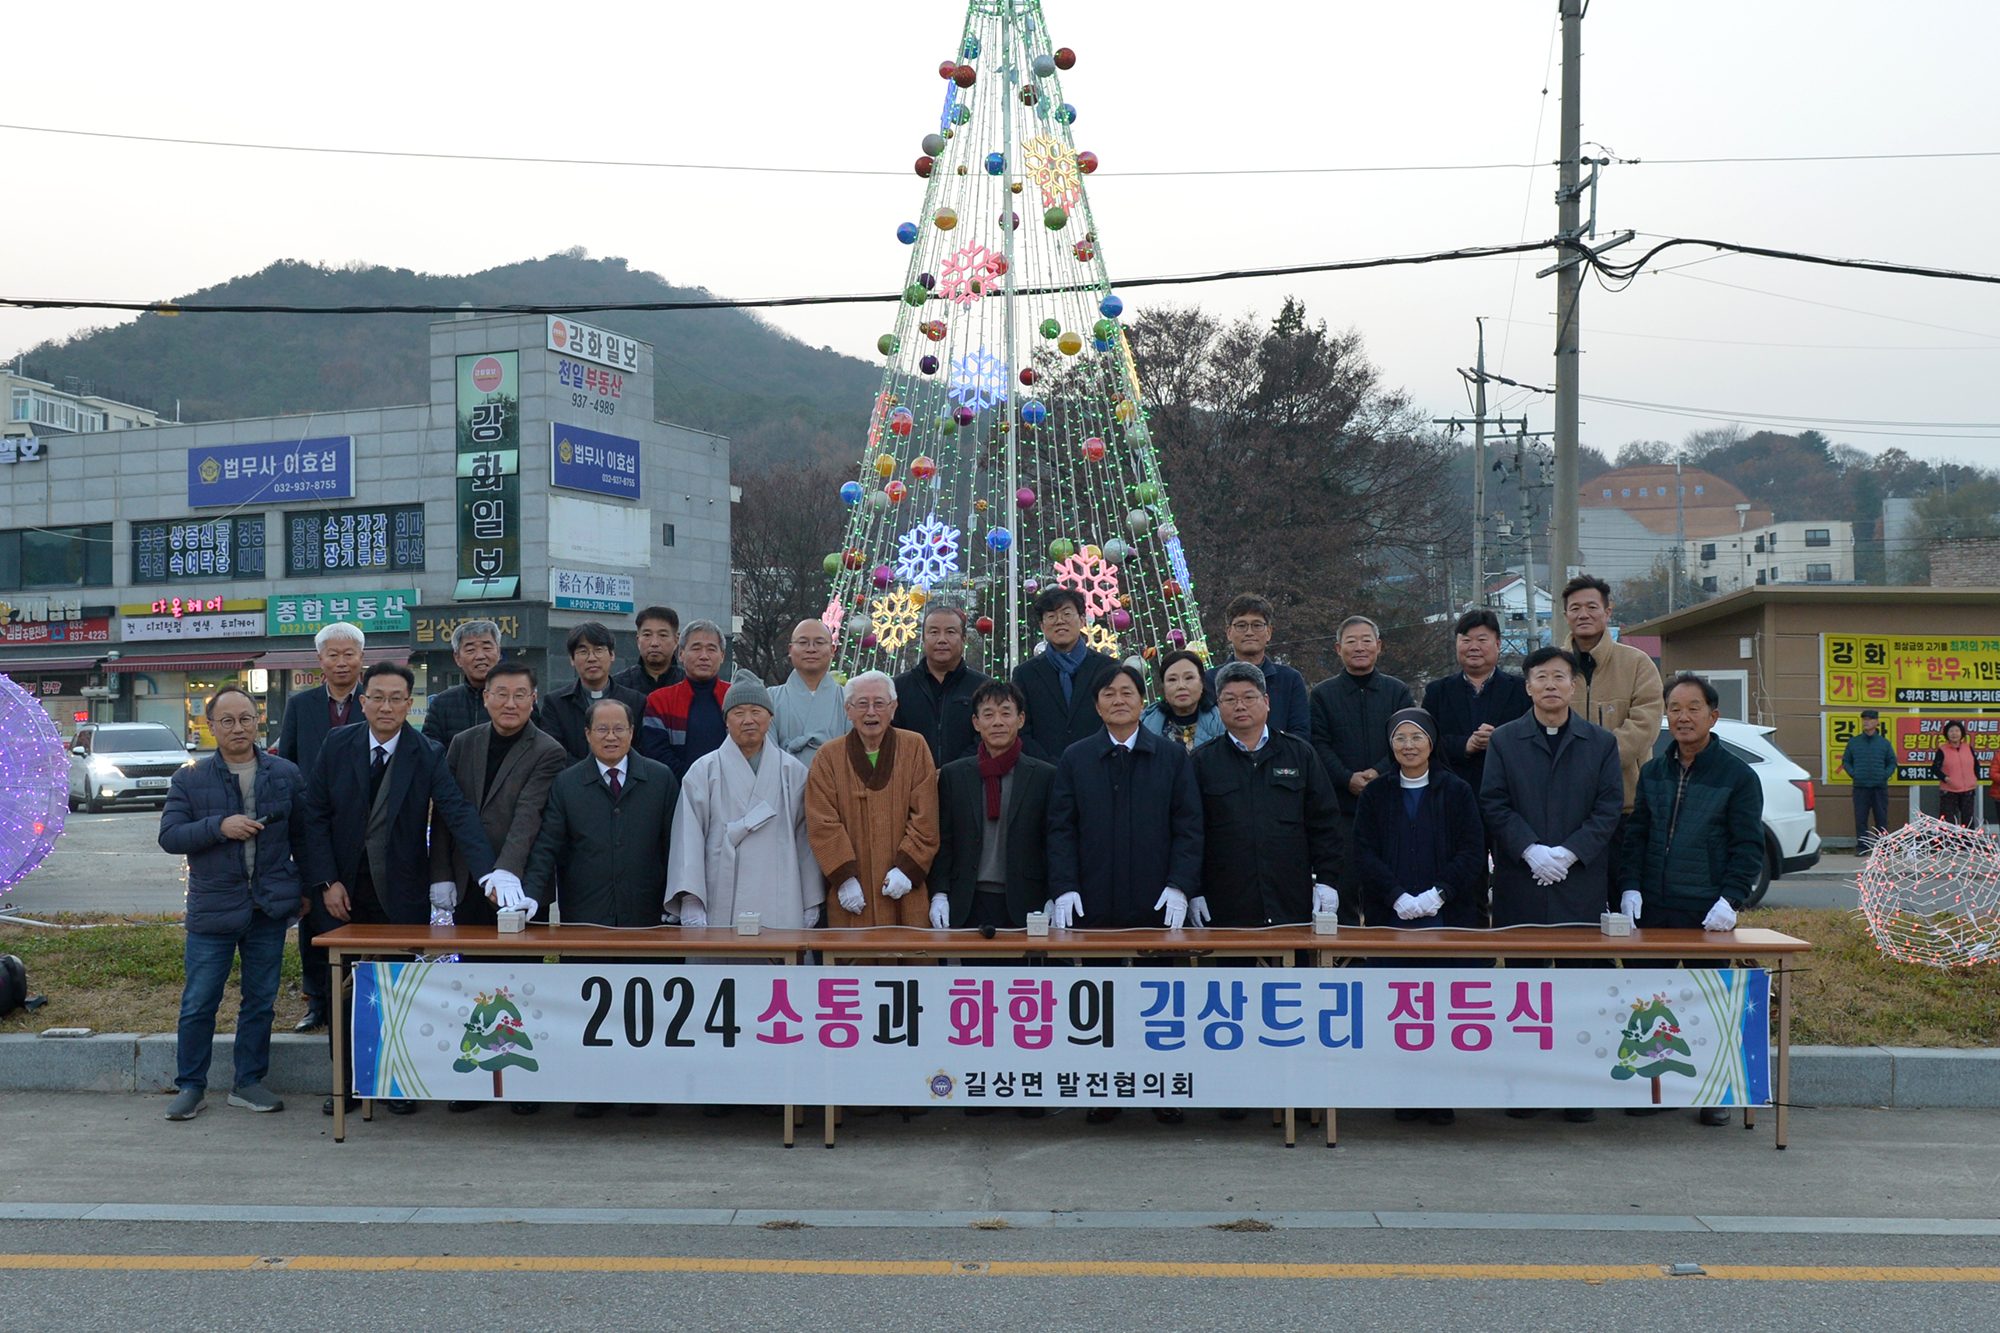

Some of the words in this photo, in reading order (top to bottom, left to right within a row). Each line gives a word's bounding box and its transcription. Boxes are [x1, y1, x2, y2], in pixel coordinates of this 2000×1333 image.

[569, 325, 637, 369] 강화일보
[559, 359, 623, 398] 천일부동산
[572, 393, 615, 416] 937-4989
[224, 455, 277, 479] 법무사
[284, 451, 336, 474] 이효섭
[575, 443, 604, 468] 법무사
[607, 451, 635, 474] 이효섭
[602, 473, 635, 487] 032-937-8755
[274, 480, 337, 493] 032-937-8755
[472, 403, 504, 585] 강화일보
[170, 526, 184, 575] 상속
[185, 525, 198, 574] 증여
[200, 524, 214, 573] 신탁
[216, 523, 230, 572] 근저당
[238, 521, 251, 572] 경매
[252, 521, 264, 571] 공매
[324, 516, 339, 567] 소장
[341, 516, 354, 566] 가등기
[358, 514, 371, 565] 가압류
[373, 513, 387, 565] 가처분
[396, 512, 409, 564] 회생
[410, 512, 424, 563] 파산
[69, 621, 88, 629] 032-
[151, 595, 223, 618] 다올헤어
[276, 596, 406, 623] 종합부동산
[69, 631, 107, 640] 937-4225
[416, 616, 519, 642] 길상자
[1832, 642, 1886, 665] 강화
[1832, 676, 1887, 699] 가경
[581, 976, 741, 1048] 2024
[756, 978, 923, 1049] 소통과
[948, 978, 1114, 1050] 화합의
[1140, 980, 1363, 1051] 길상트리
[1387, 981, 1553, 1051] 점등식
[964, 1071, 1043, 1097] 길상면
[1057, 1071, 1194, 1098] 발전협의회
